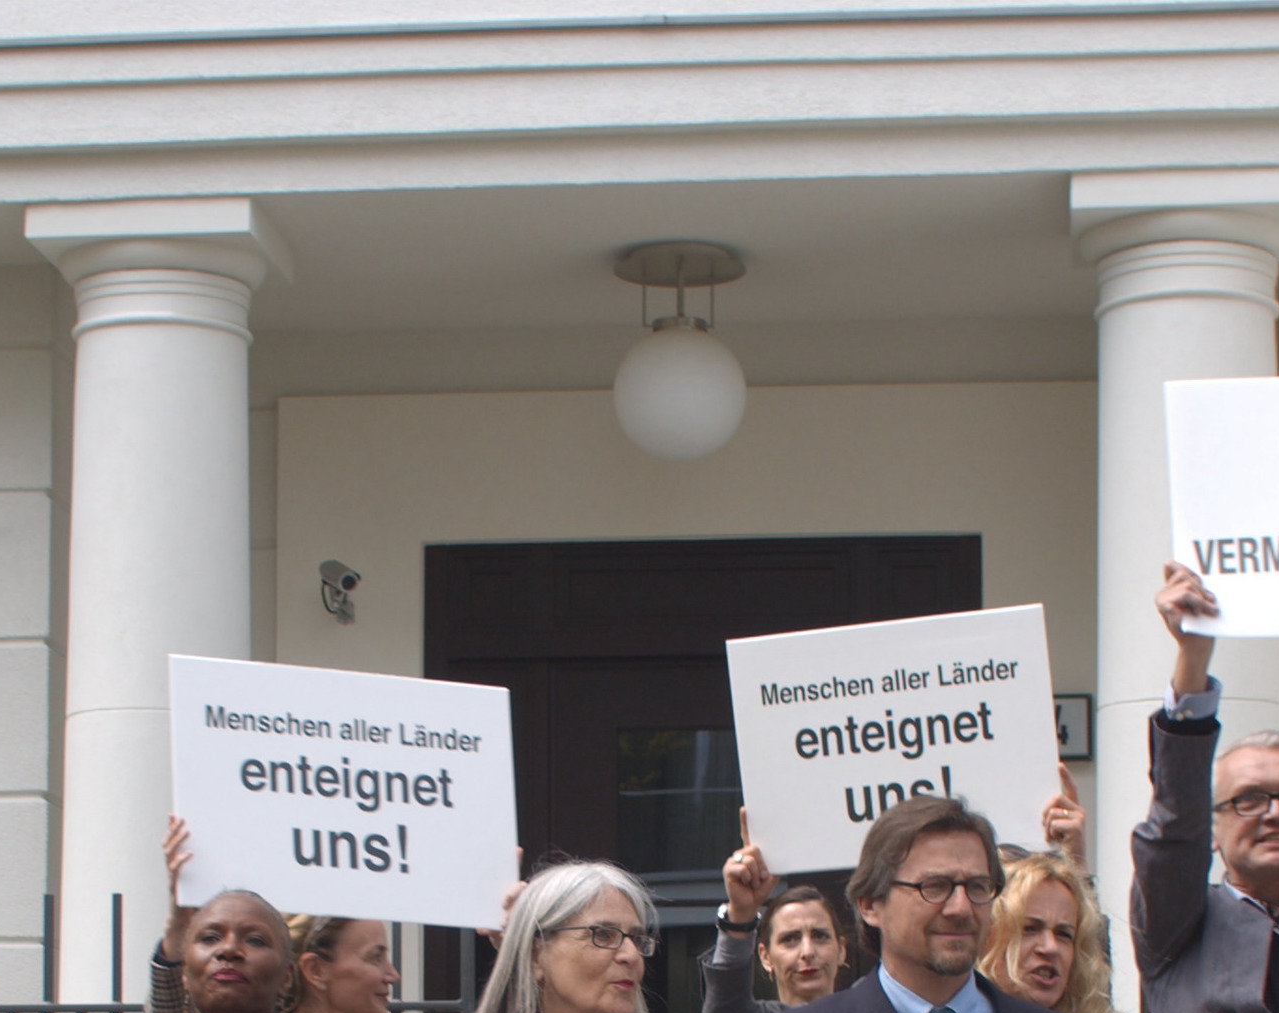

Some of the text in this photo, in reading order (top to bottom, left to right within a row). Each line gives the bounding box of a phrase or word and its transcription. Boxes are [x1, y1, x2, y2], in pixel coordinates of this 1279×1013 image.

[760, 658, 1019, 706] Menschen aller Länder
[205, 704, 482, 753] Menschen aller Länder
[795, 701, 994, 760] enteignet
[240, 755, 454, 813] enteignet
[292, 824, 410, 874] uns!
